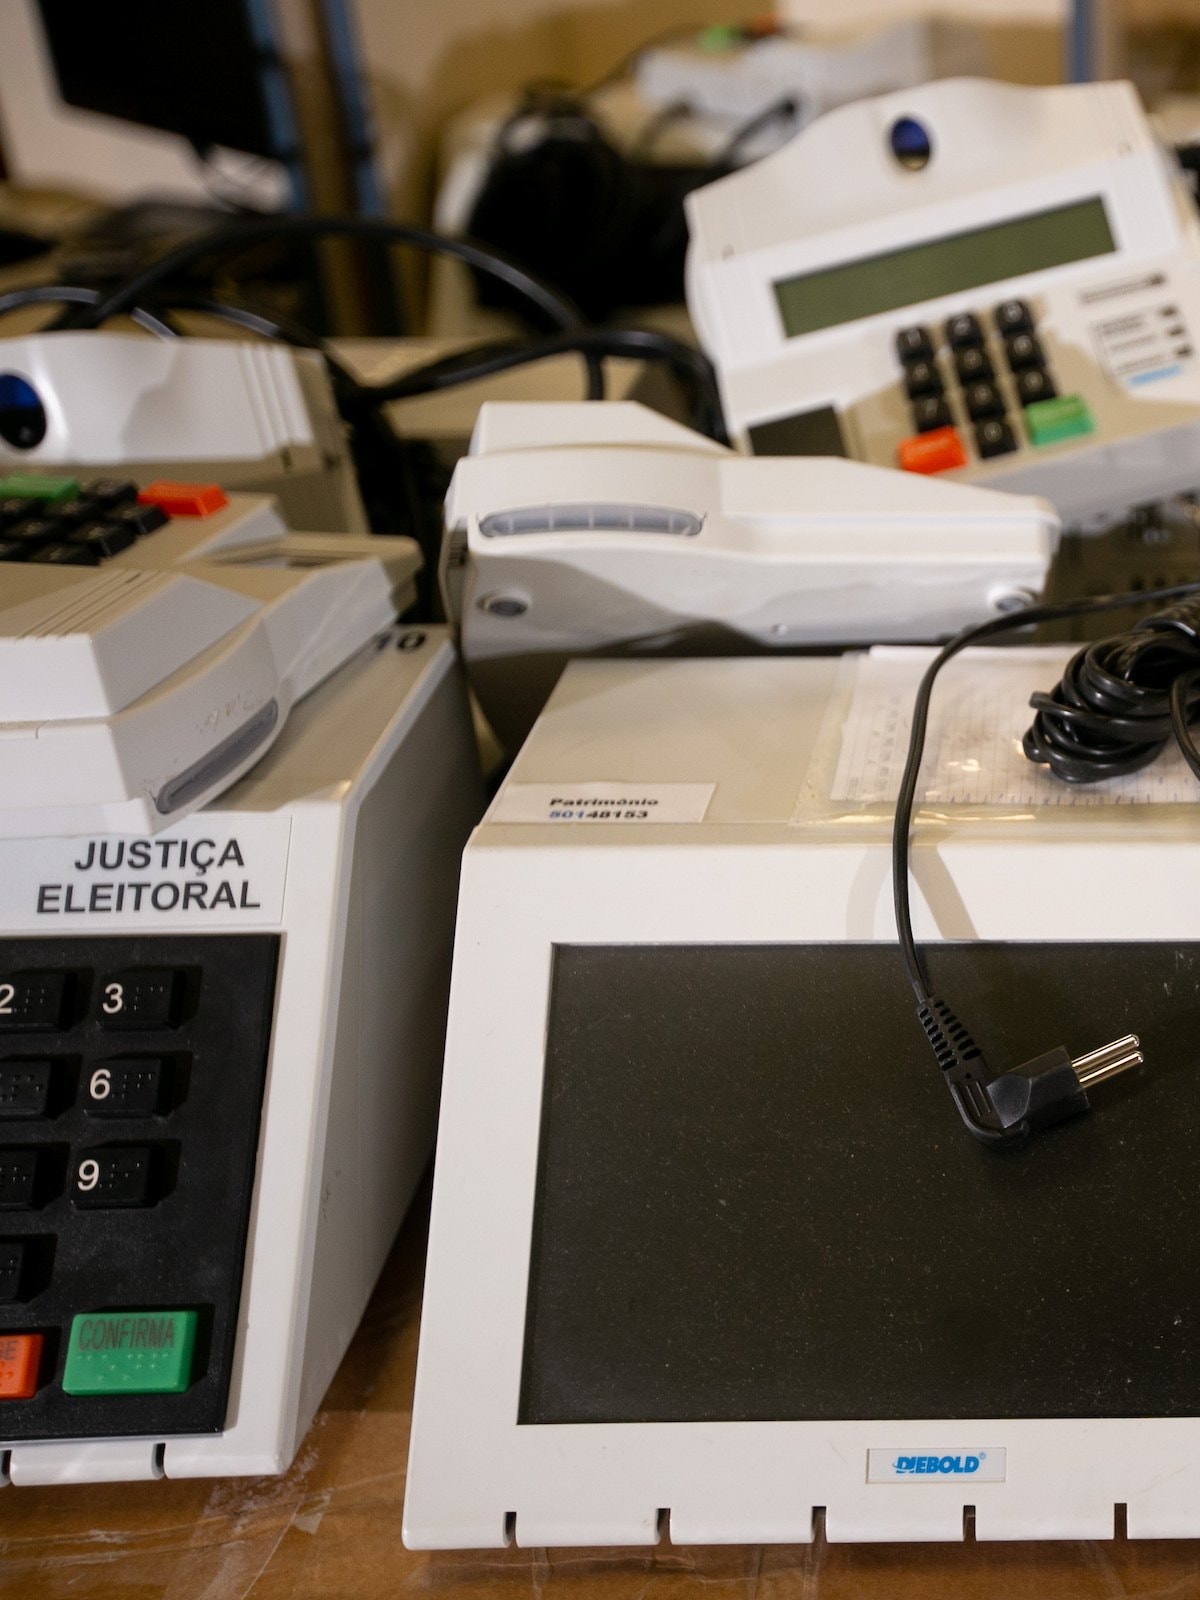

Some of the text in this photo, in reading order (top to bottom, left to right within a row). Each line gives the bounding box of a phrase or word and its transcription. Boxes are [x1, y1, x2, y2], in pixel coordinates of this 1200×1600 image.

[549, 797, 659, 806] Patrimônio
[75, 840, 244, 876] JUSTIÇA
[37, 882, 260, 913] ELEITORAL
[103, 984, 122, 1013] 3
[90, 1069, 110, 1099] 6
[78, 1160, 99, 1190] 9
[78, 1318, 175, 1351] CONFIRMA
[892, 1455, 979, 1473] DIEBOLD
